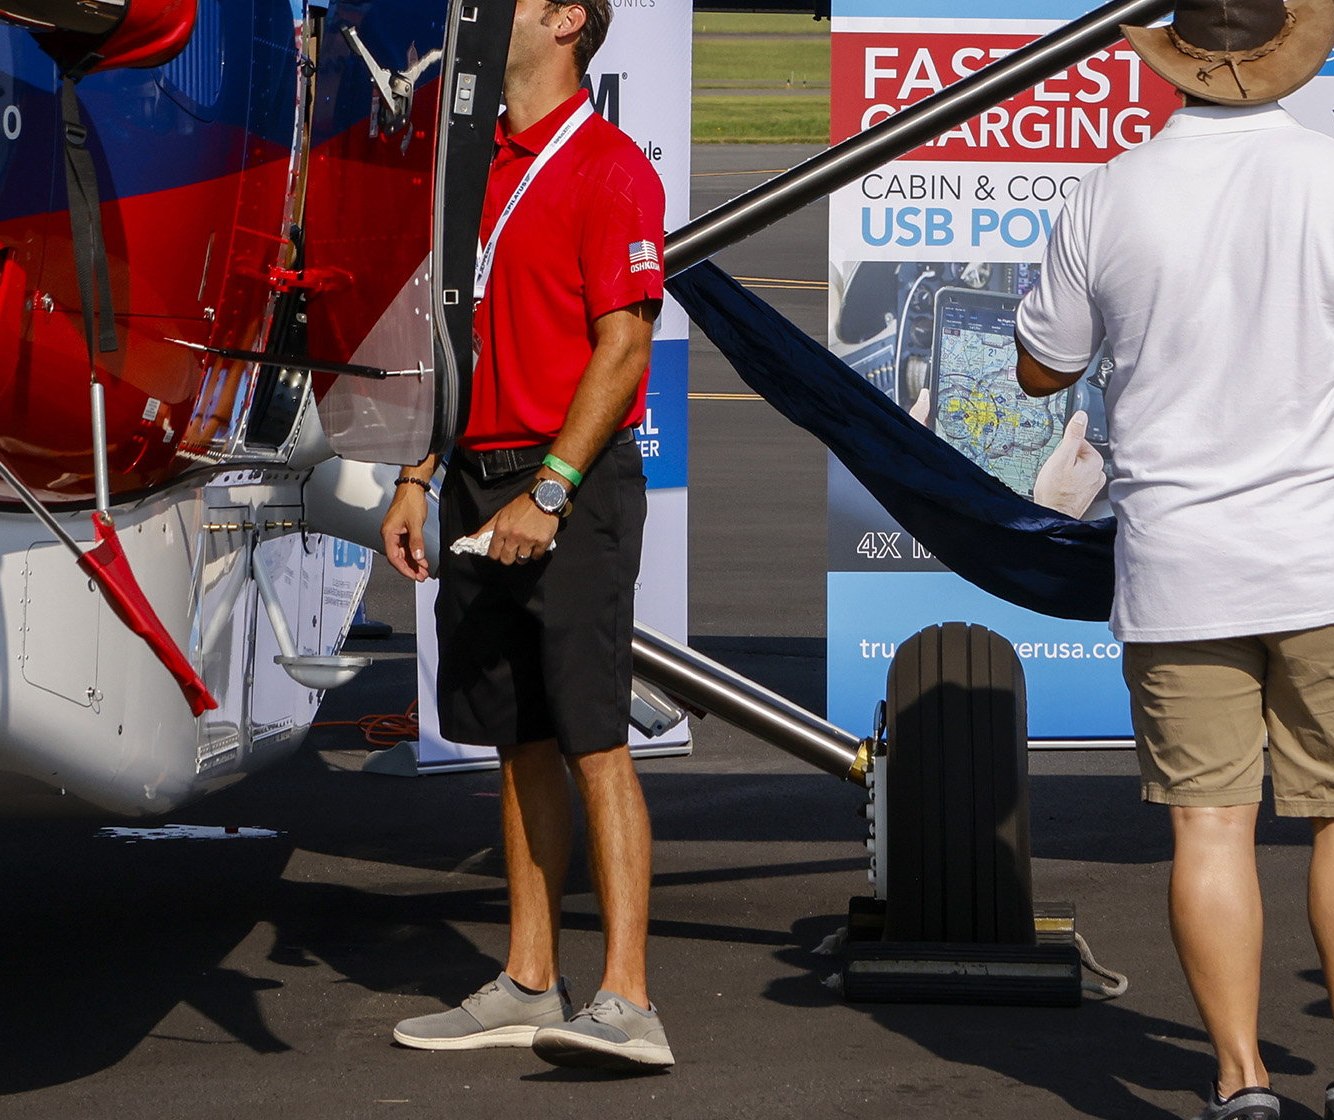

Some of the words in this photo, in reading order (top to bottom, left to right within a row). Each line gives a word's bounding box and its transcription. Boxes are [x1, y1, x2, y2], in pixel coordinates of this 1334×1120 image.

[864, 47, 1145, 103] FASEST
[860, 104, 1151, 150] CARGING
[861, 173, 962, 200] CABIN
[974, 174, 996, 201] &
[861, 206, 955, 247] USB
[856, 532, 902, 558] 4X
